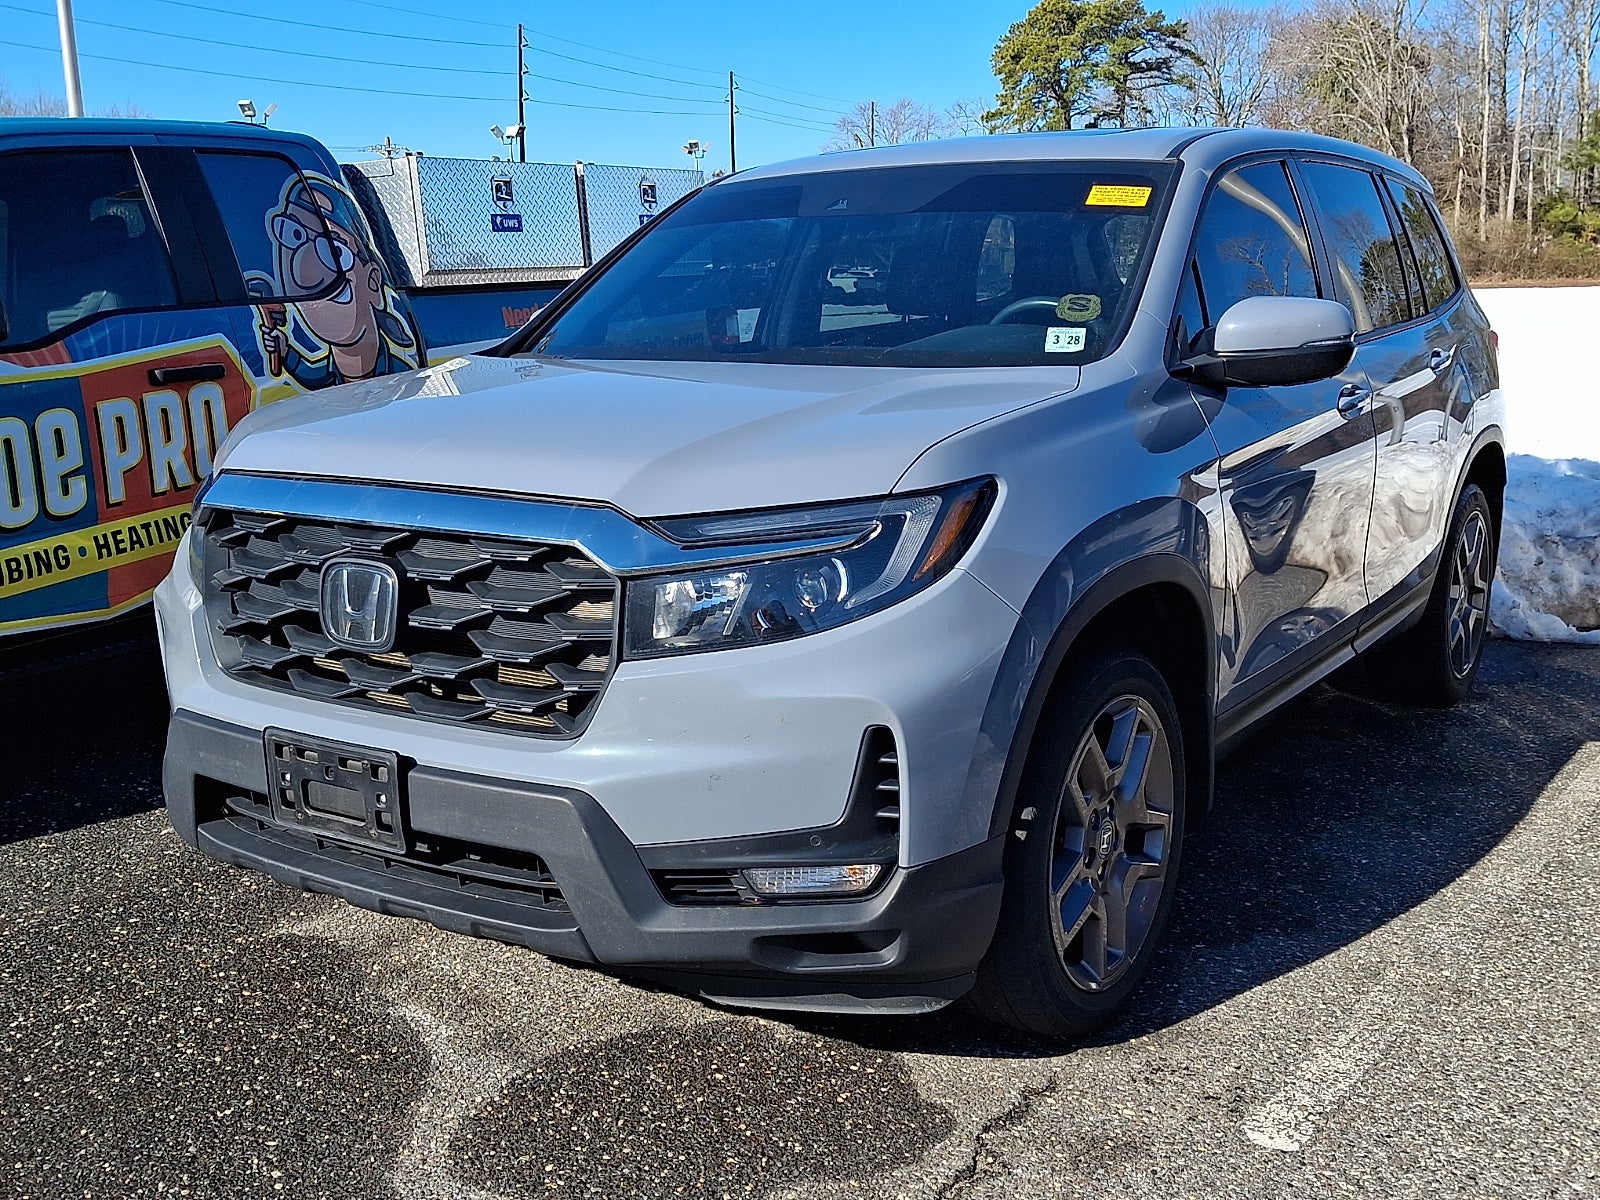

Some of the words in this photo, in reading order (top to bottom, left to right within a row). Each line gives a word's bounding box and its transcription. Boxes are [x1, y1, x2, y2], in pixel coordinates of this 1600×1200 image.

[503, 219, 518, 228] UWS
[1052, 334, 1060, 345] 3
[1066, 335, 1081, 345] 28
[95, 381, 229, 507] PRO
[0, 543, 71, 587] BING
[92, 511, 192, 561] HEATING
